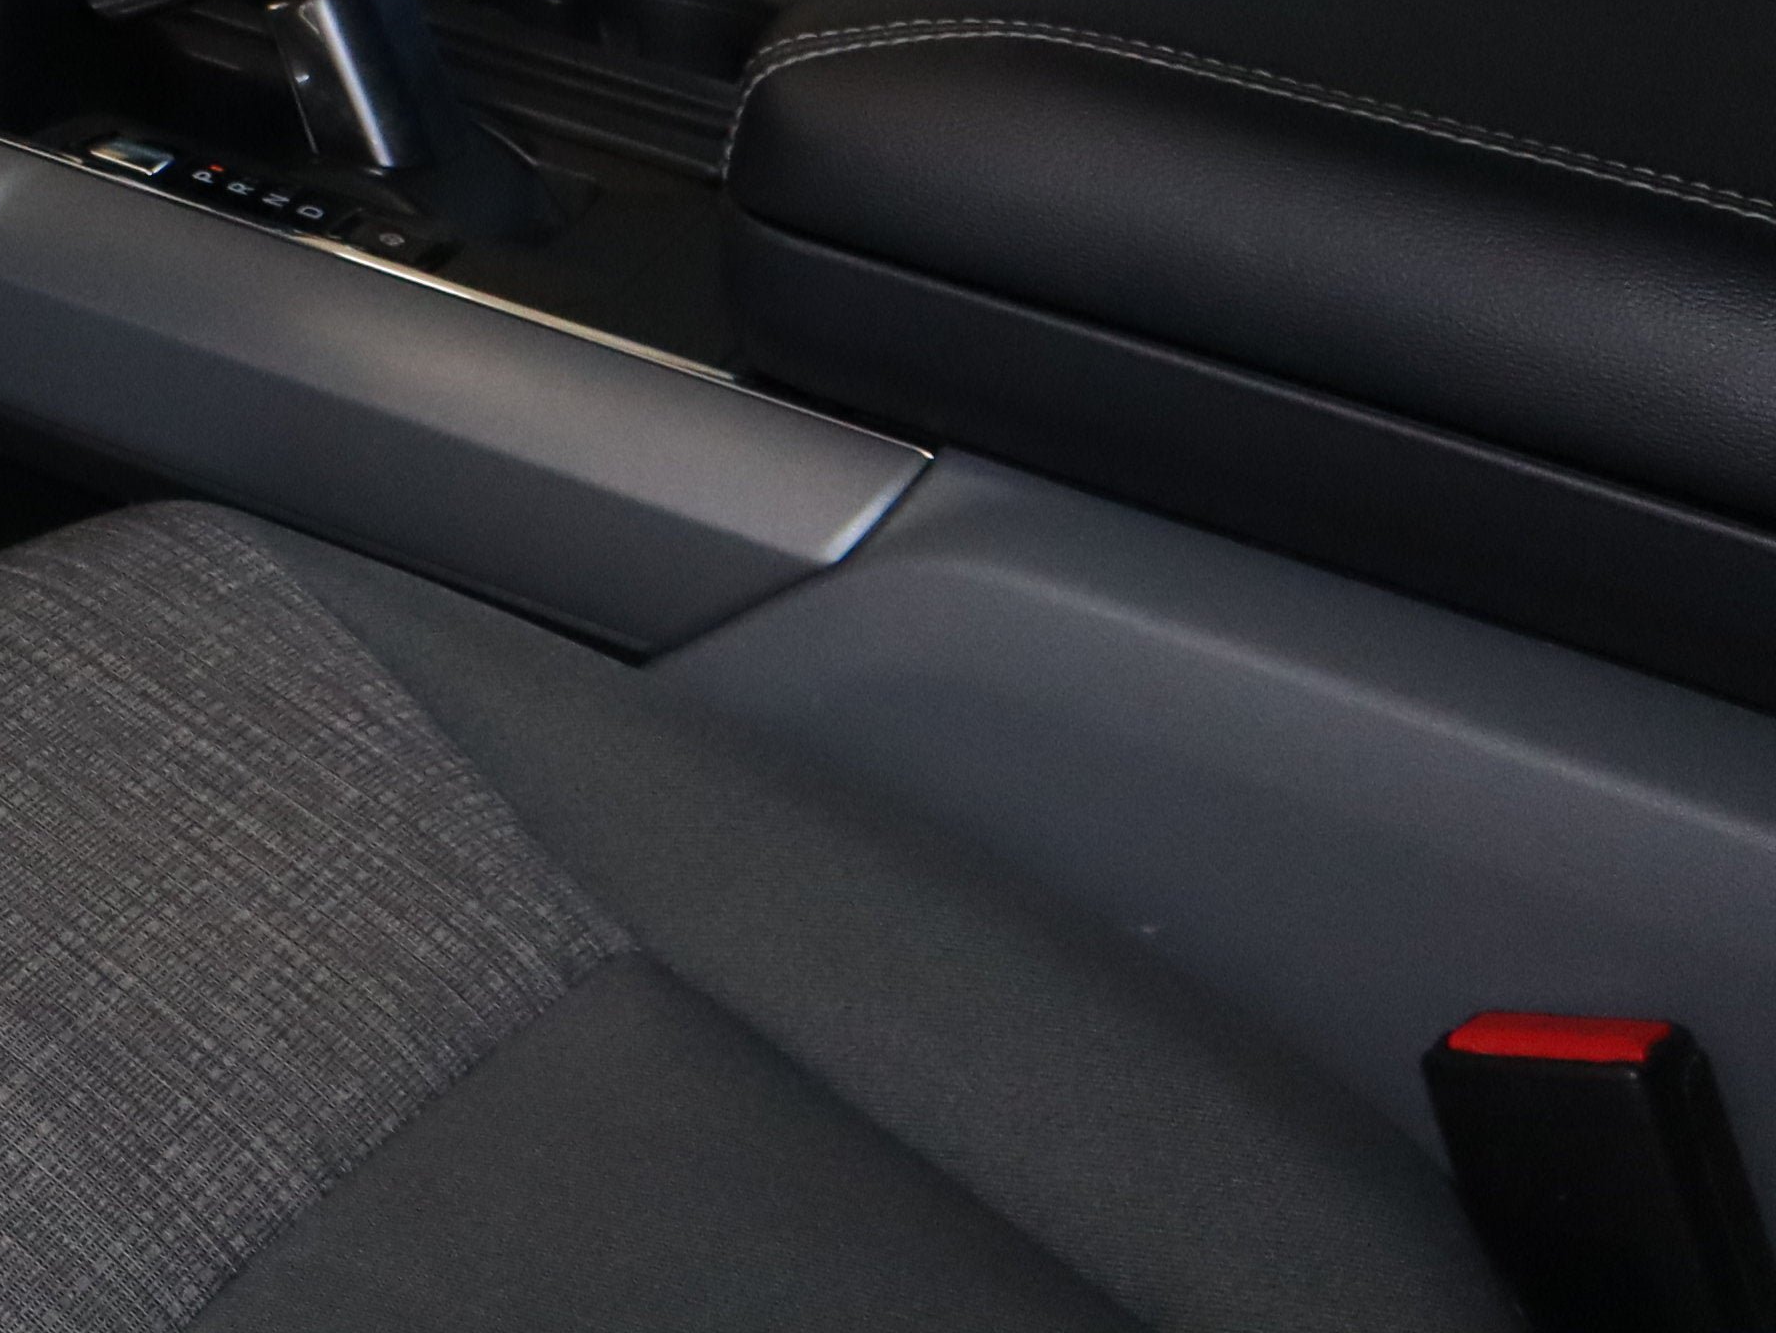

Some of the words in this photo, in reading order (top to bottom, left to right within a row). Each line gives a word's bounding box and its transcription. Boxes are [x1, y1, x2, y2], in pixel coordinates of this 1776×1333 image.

[191, 170, 214, 184] P
[227, 182, 255, 196] R
[297, 205, 324, 220] D
